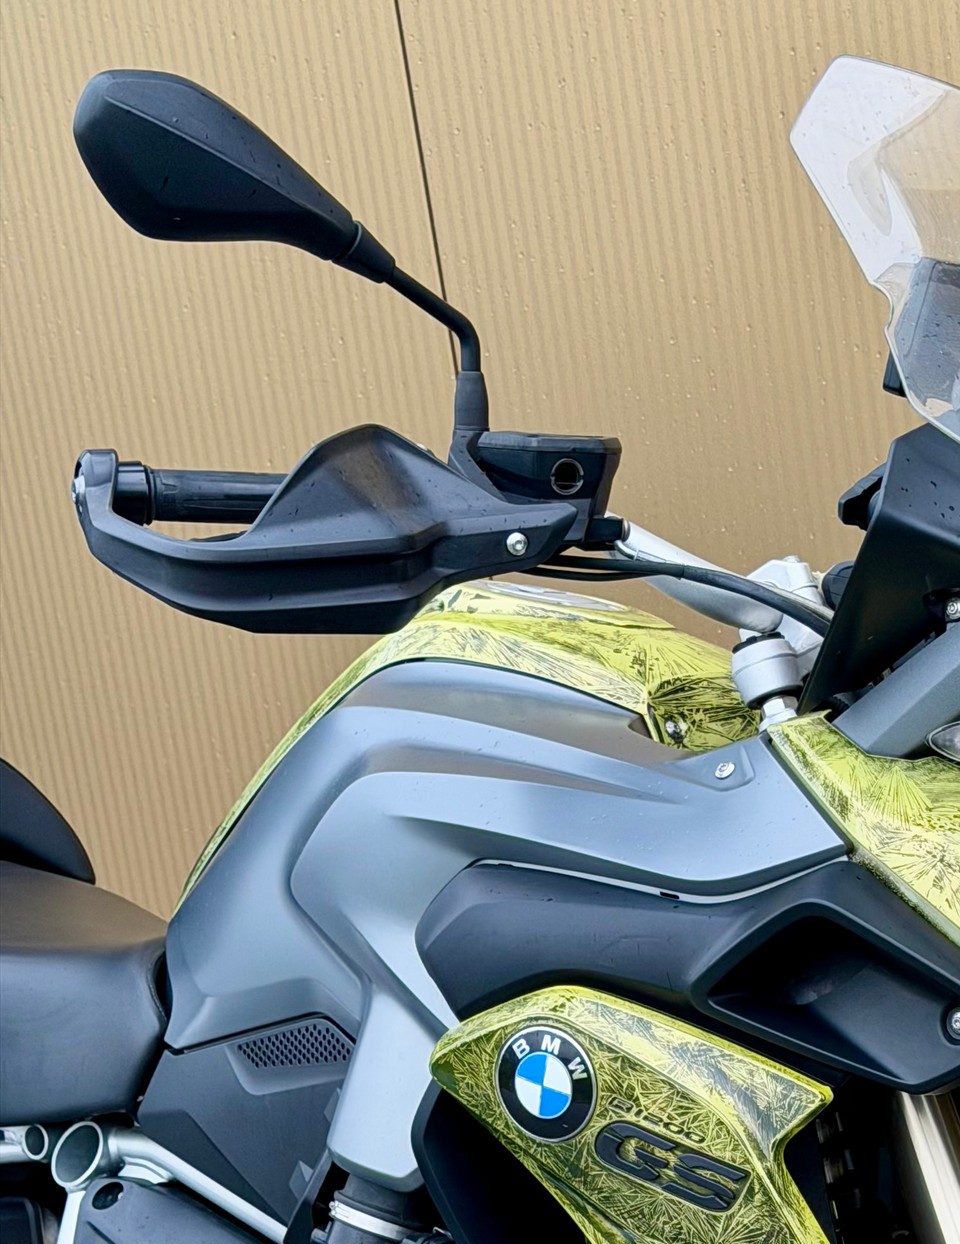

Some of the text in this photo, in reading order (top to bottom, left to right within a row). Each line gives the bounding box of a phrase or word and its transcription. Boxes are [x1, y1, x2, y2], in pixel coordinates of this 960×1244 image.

[512, 1034, 588, 1081] BMW
[607, 1096, 706, 1144] R1200
[594, 1122, 748, 1209] GS
